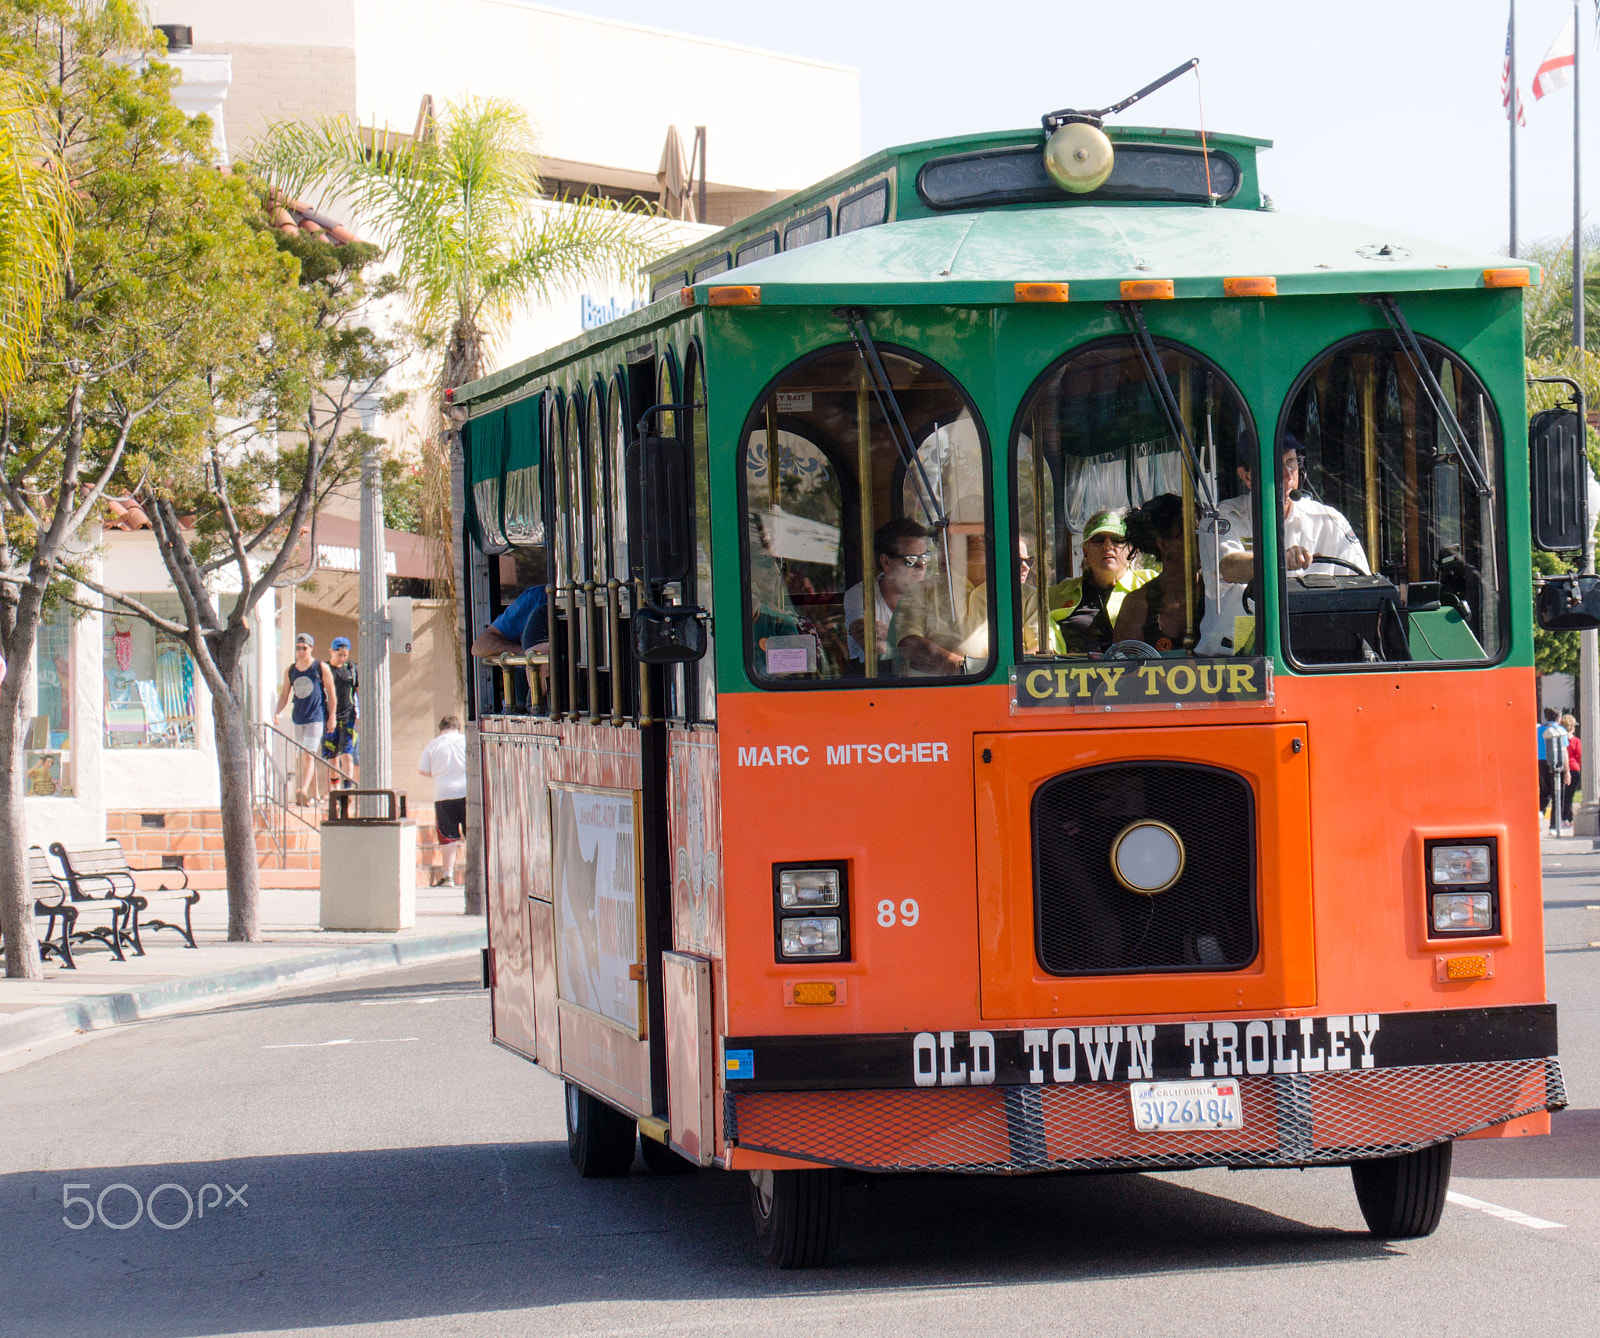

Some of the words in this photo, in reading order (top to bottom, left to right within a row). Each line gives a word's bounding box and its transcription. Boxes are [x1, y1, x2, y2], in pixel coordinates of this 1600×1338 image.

[1025, 667, 1125, 699] CITY
[1138, 664, 1257, 695] TOUR
[738, 745, 810, 767] MARC
[826, 742, 949, 765] MITSCHER
[877, 898, 920, 928] 89
[913, 1031, 996, 1086] OLD
[1023, 1024, 1156, 1084] TOWN
[1184, 1014, 1380, 1077] TROLLEY
[1157, 1087, 1213, 1097] CALIFORNIA
[1140, 1099, 1233, 1124] 3V26184
